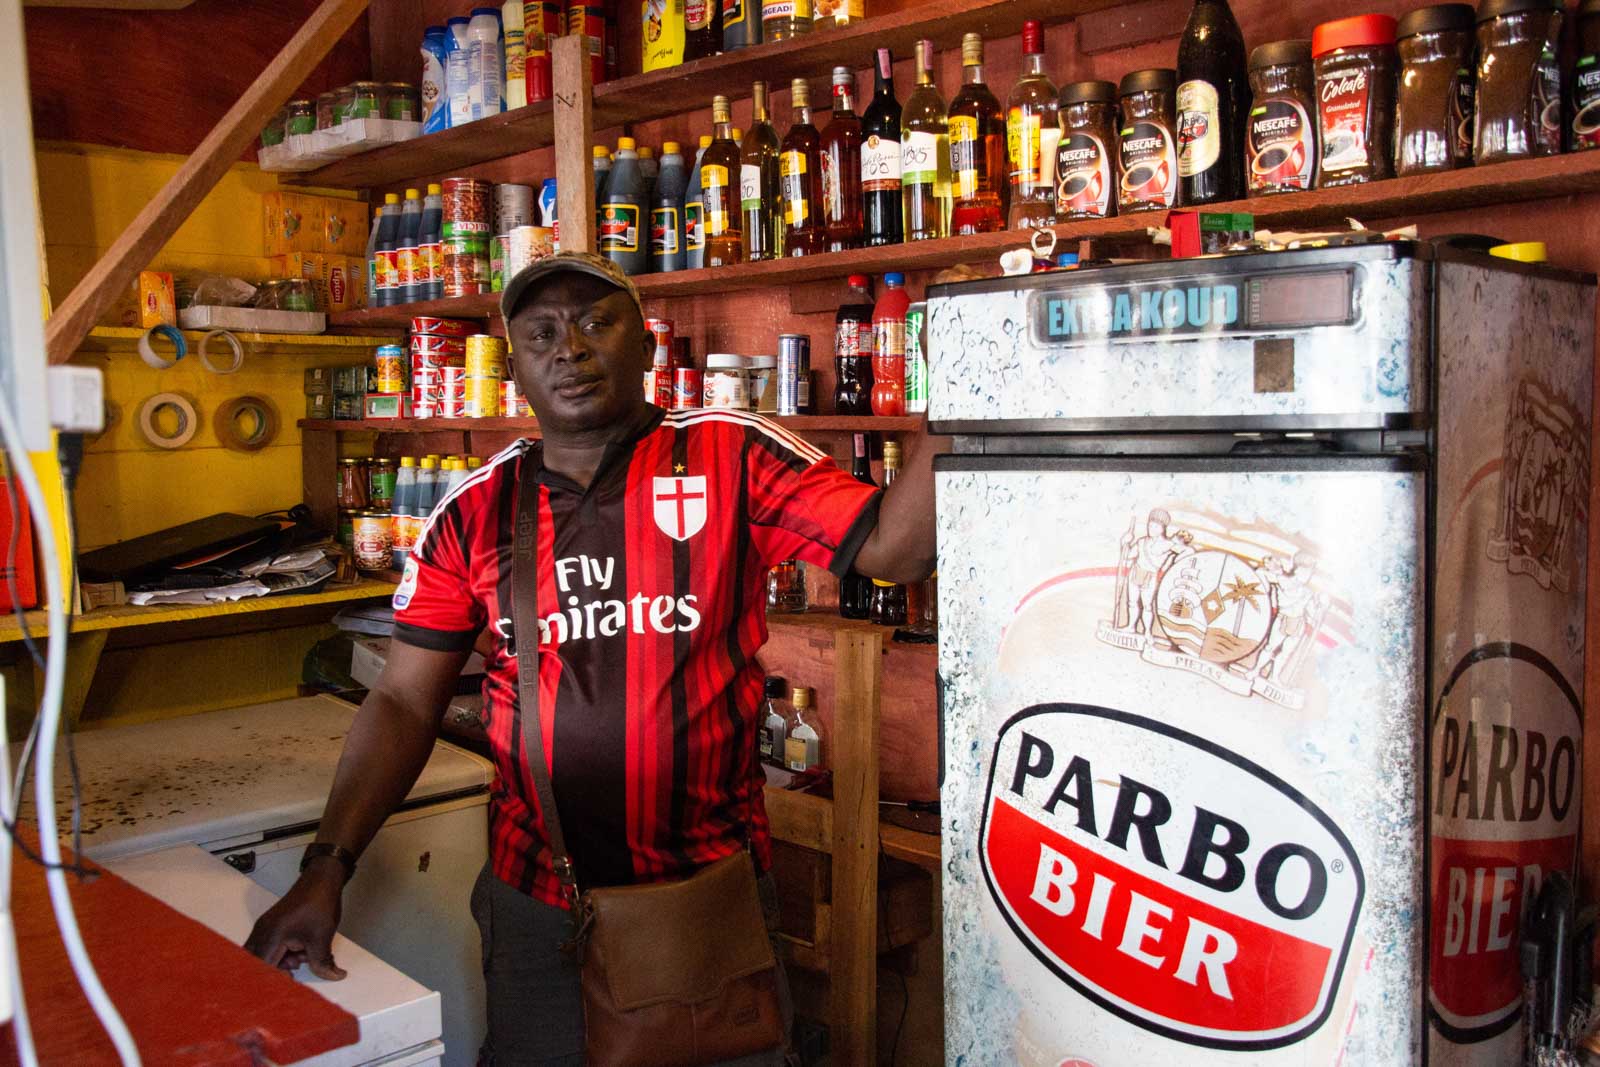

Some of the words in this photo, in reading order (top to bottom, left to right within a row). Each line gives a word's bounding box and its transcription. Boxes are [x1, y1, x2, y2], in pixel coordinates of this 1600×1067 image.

[332, 270, 342, 302] Lipton
[1140, 284, 1238, 330] KOUD
[555, 555, 615, 592] Fly
[1175, 656, 1222, 681] PIETAS
[1434, 717, 1576, 822] PARBO
[1009, 731, 1328, 920] PARBO
[1029, 843, 1238, 1001] BIER
